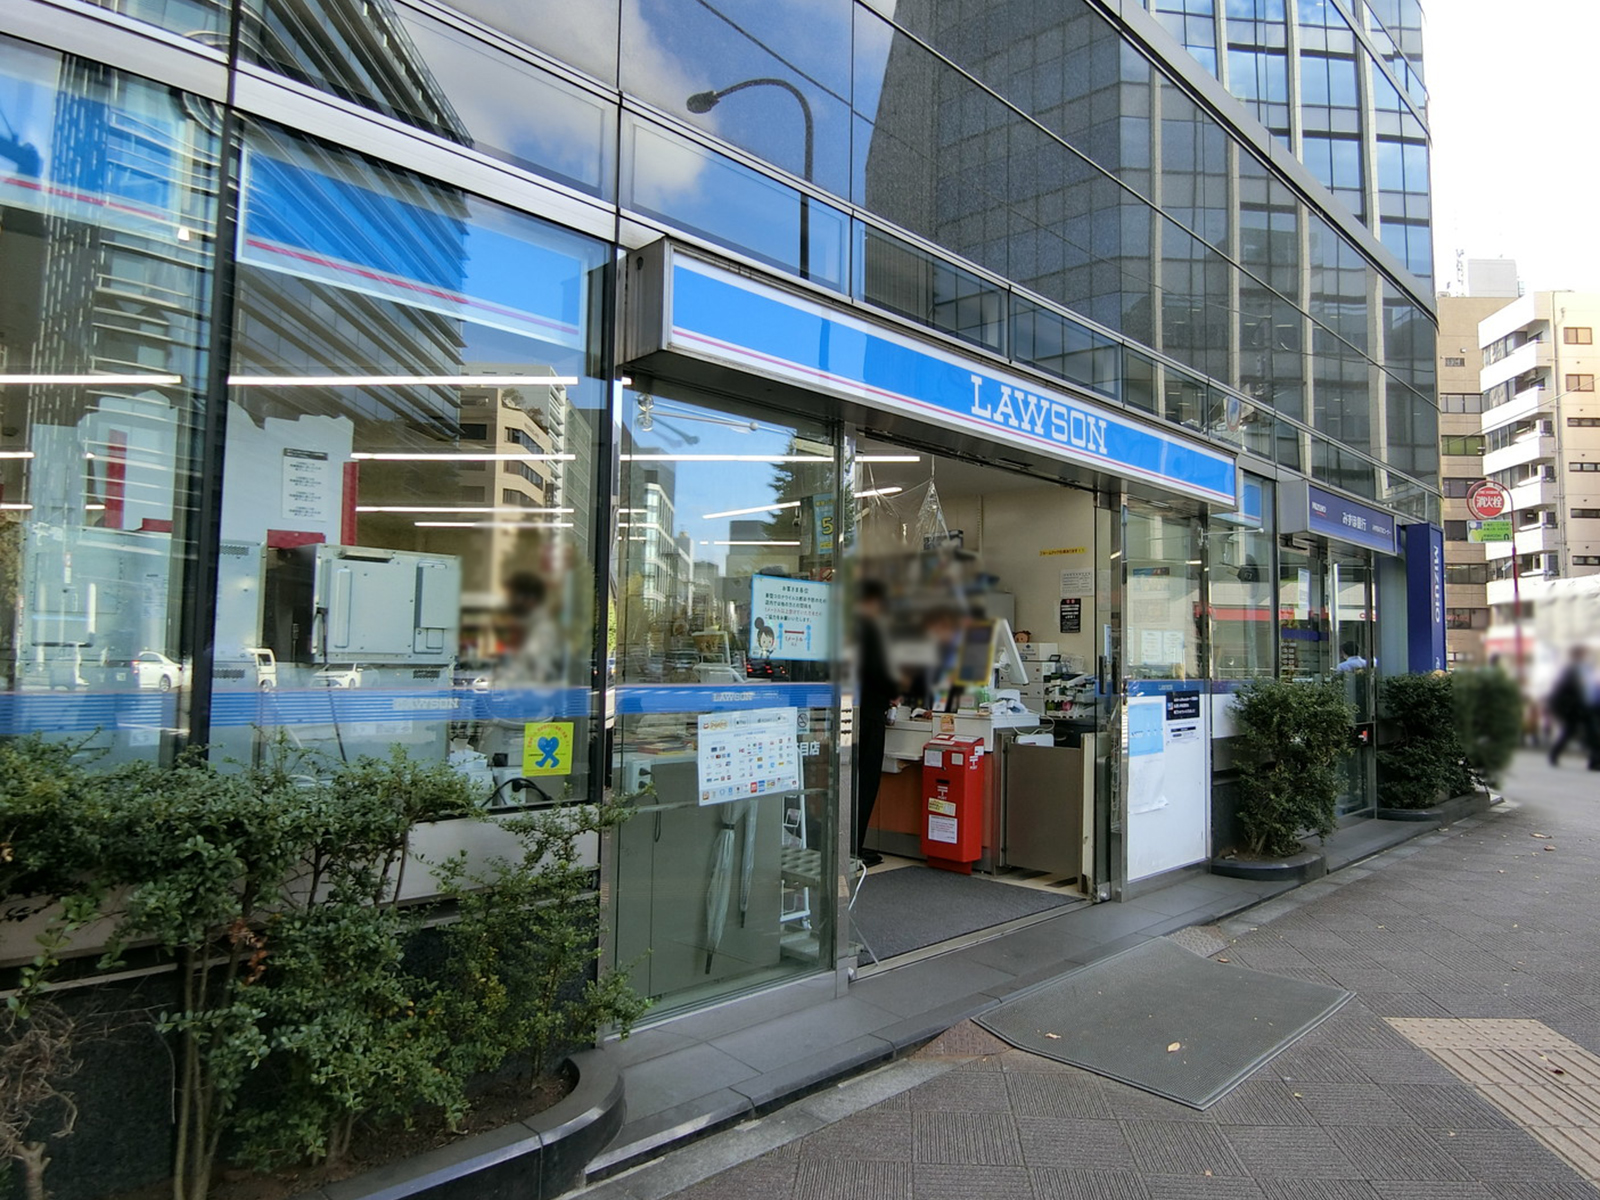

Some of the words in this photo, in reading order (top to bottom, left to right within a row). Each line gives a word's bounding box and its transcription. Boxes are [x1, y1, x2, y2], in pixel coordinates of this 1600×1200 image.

[971, 374, 1107, 455] LAWSON
[1476, 496, 1502, 508] 消火栓
[821, 517, 834, 535] 5
[1342, 511, 1367, 533] みずほ銀行
[782, 586, 809, 594] お客さま各位
[1433, 545, 1442, 623] MIZUHO
[713, 692, 754, 702] LAWSON
